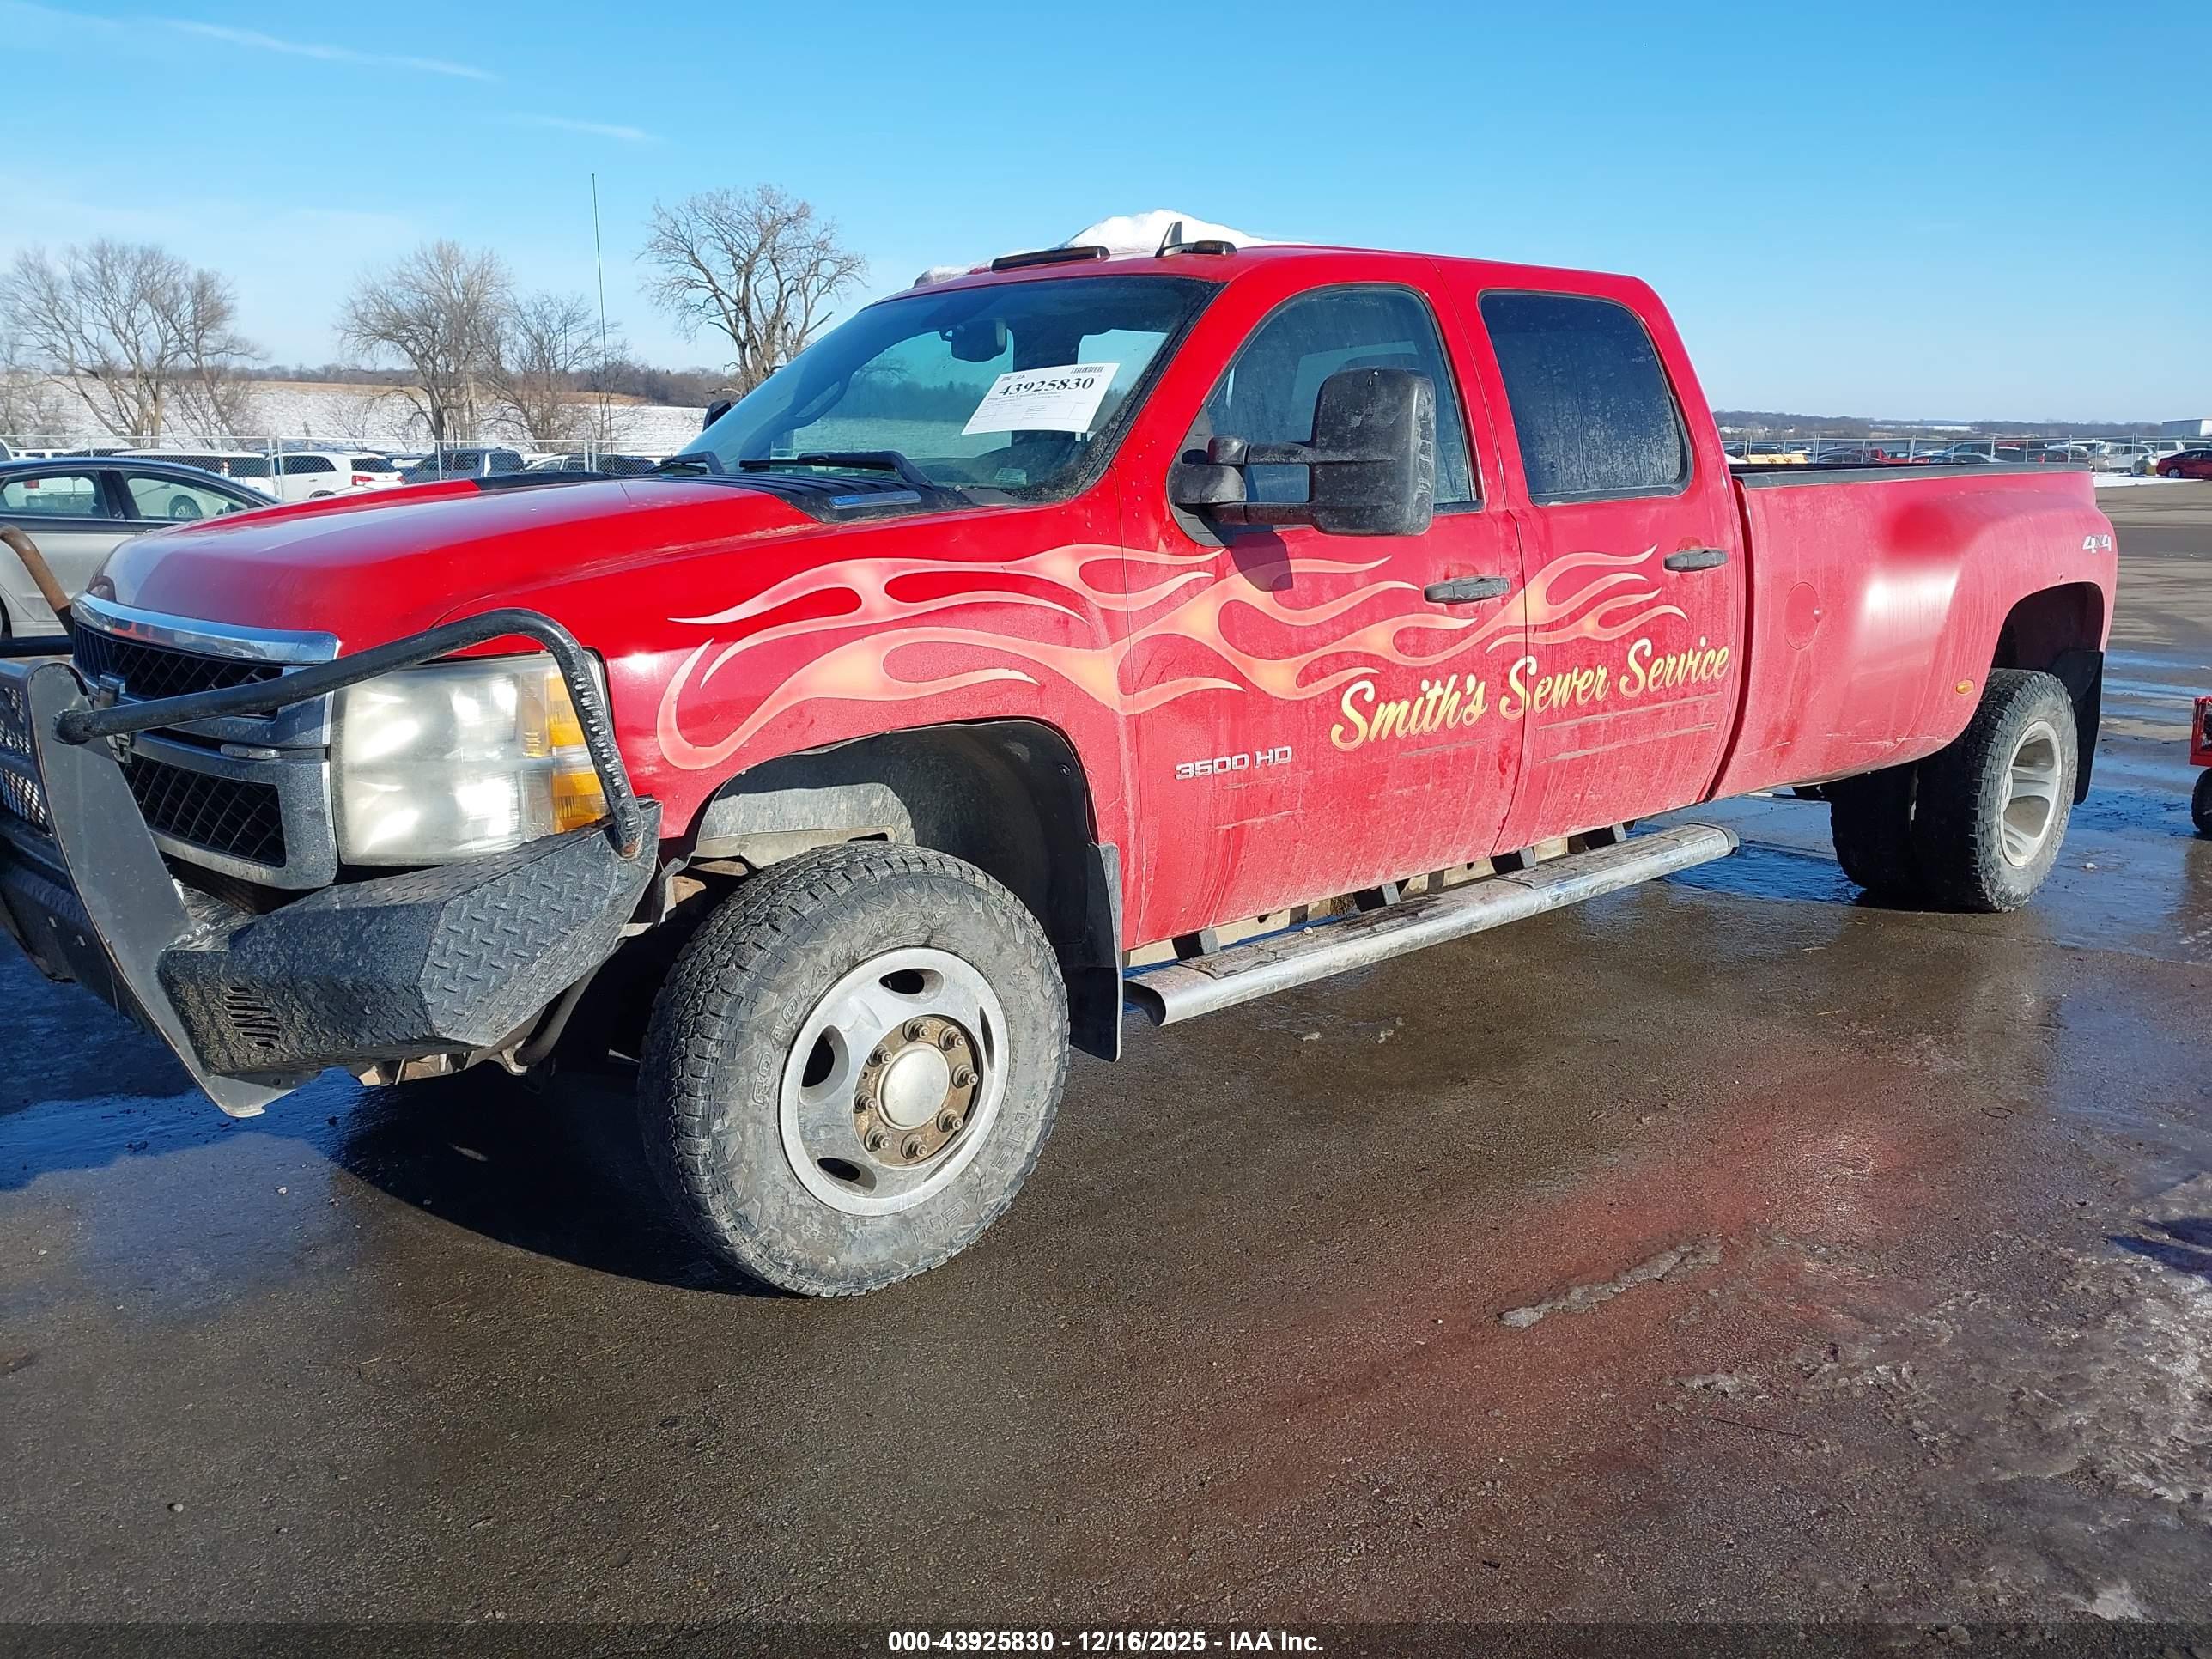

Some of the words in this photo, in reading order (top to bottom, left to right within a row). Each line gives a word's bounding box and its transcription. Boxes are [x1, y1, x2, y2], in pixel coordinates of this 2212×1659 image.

[999, 377, 1095, 396] 43925830
[1330, 673, 1488, 752] Smith's
[1498, 655, 1611, 721] Sewer
[1620, 636, 1730, 699] Service
[1175, 753, 1250, 780] 3500
[1254, 745, 1292, 769] HD
